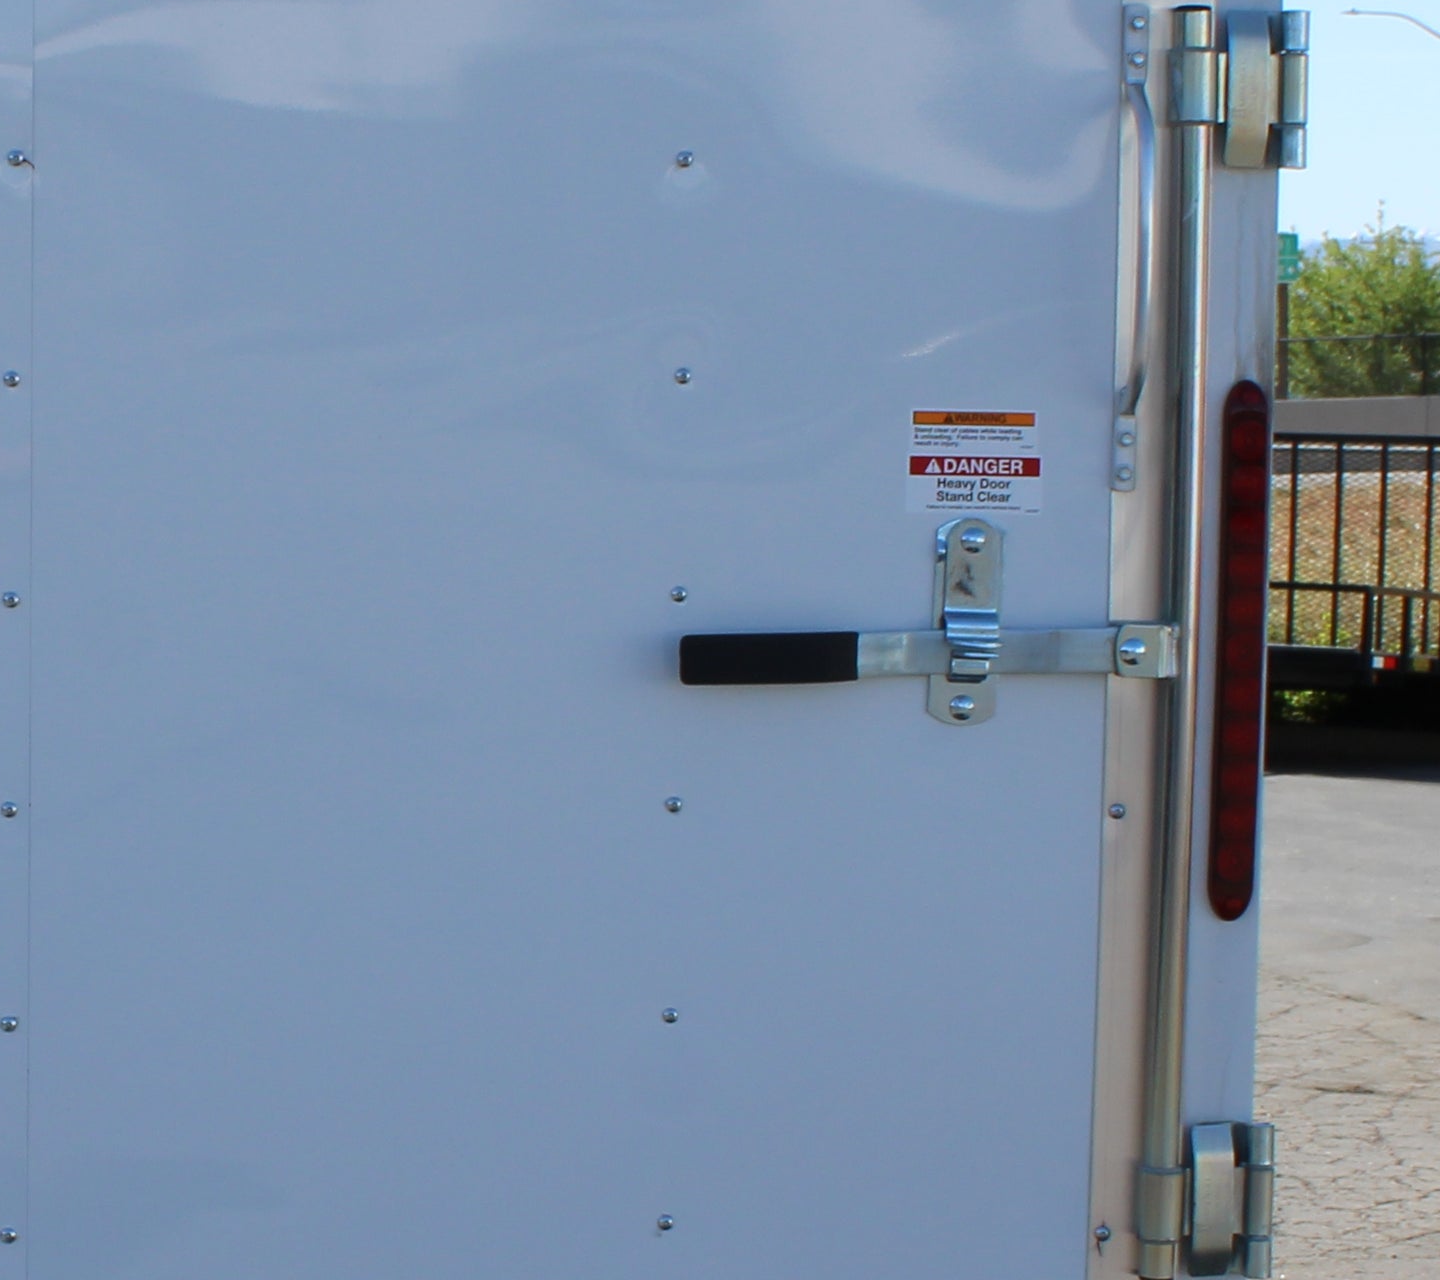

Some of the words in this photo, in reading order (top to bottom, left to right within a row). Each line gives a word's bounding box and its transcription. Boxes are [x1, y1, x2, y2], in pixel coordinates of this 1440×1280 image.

[954, 412, 1007, 424] WARNING
[943, 458, 1023, 474] DANGER
[936, 478, 976, 491] Heavy
[980, 478, 1011, 489] Door
[936, 490, 973, 502] Stand
[977, 491, 1011, 502] Clear
